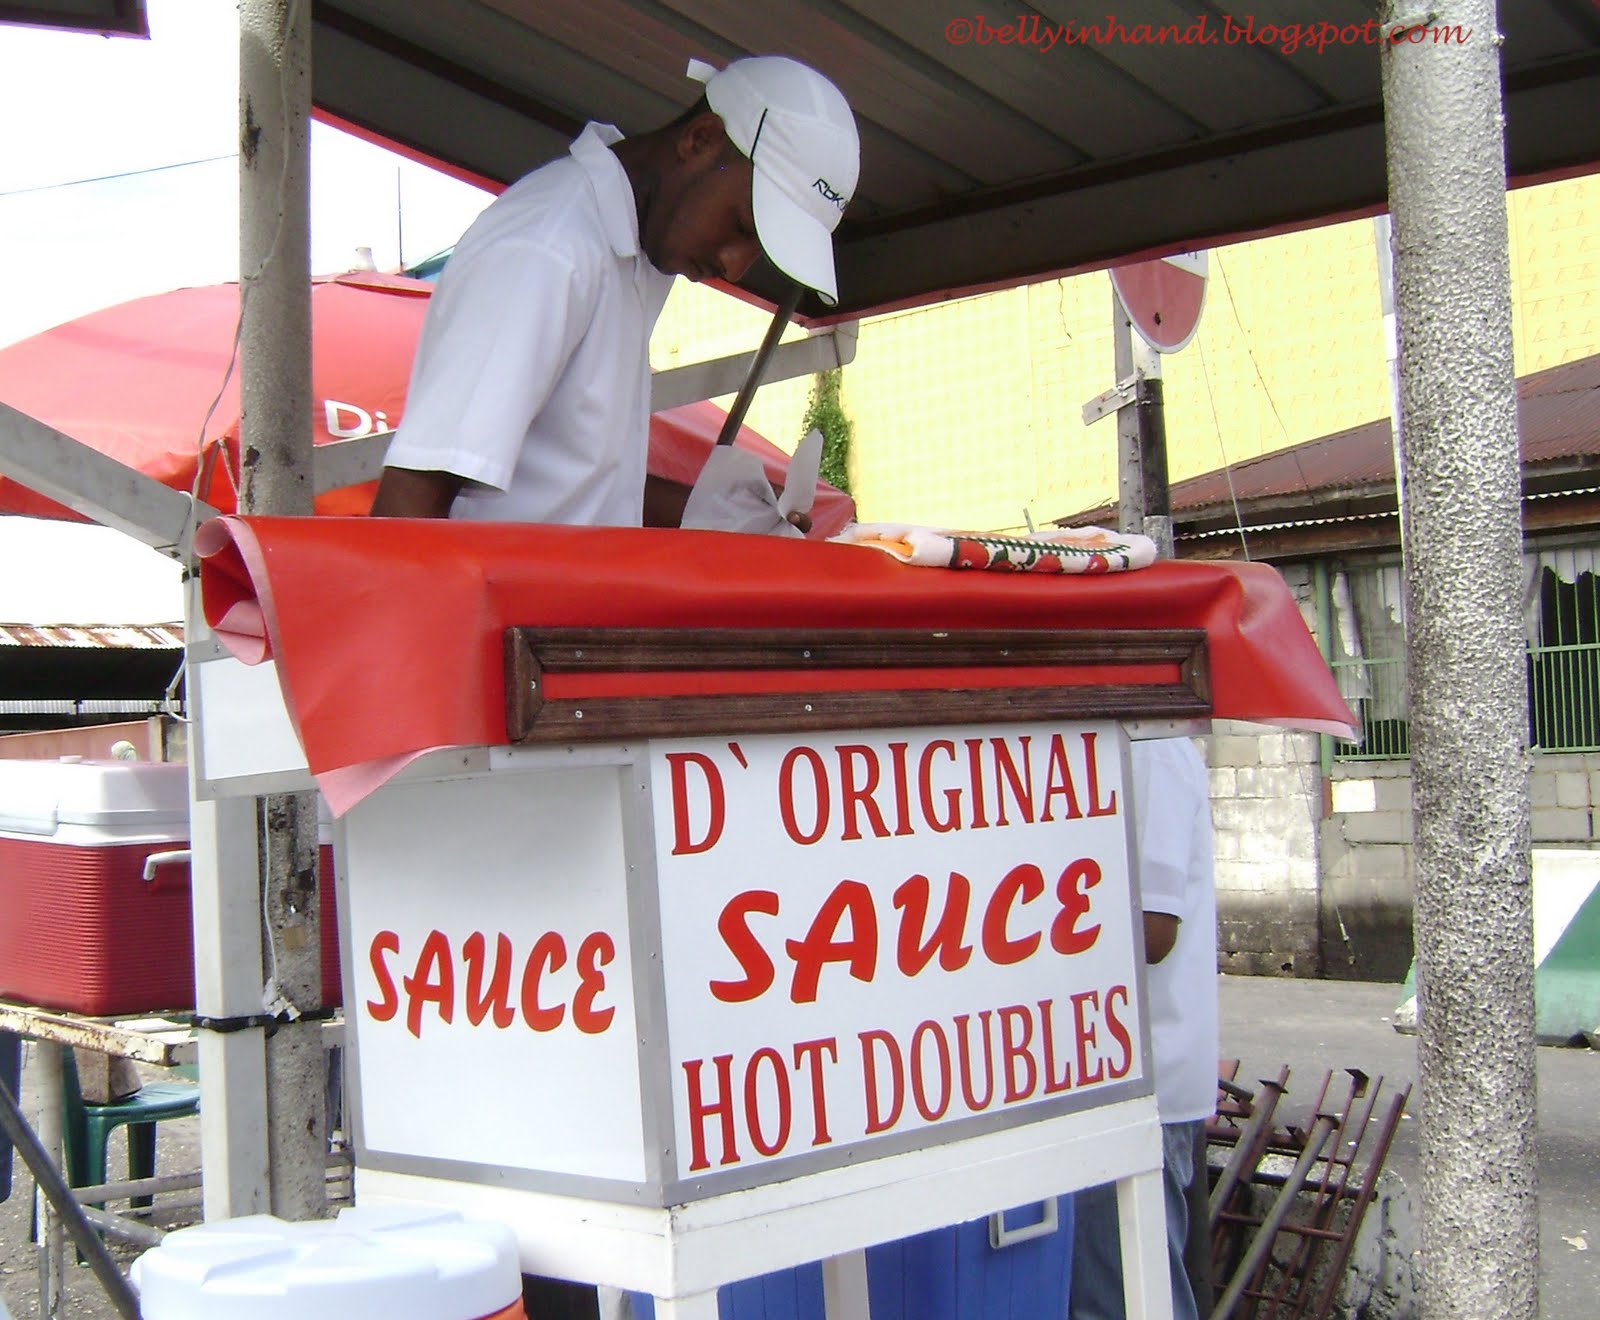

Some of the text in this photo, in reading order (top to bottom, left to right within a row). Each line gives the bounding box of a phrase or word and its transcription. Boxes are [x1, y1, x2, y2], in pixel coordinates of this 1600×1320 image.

[778, 732, 1117, 846] ORIGINAL
[366, 930, 616, 1038] SAUCE
[708, 857, 1103, 1004] SAUCE
[682, 984, 1133, 1172] HOT DOUBLES
